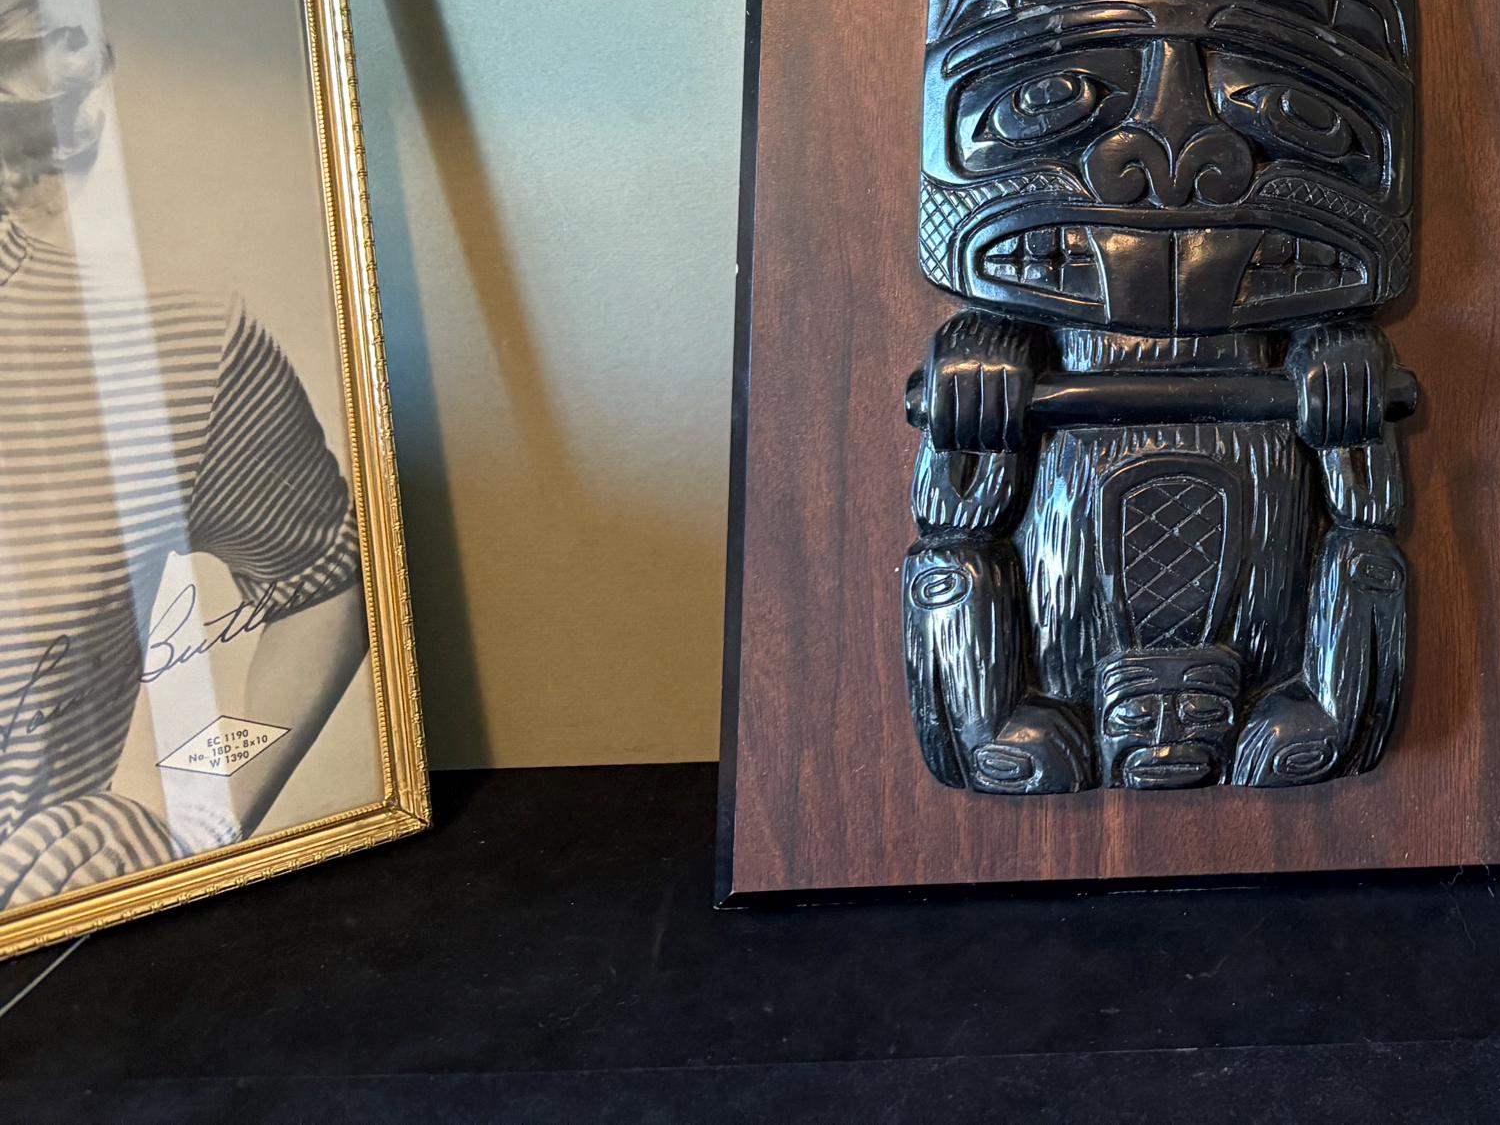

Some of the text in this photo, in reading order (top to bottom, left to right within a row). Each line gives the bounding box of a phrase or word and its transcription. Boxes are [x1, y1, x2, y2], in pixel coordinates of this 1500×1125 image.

[207, 729, 248, 747] EC 1190
[212, 745, 231, 756] 18D
[243, 735, 268, 748] 8x10
[210, 751, 249, 768] W 1390
